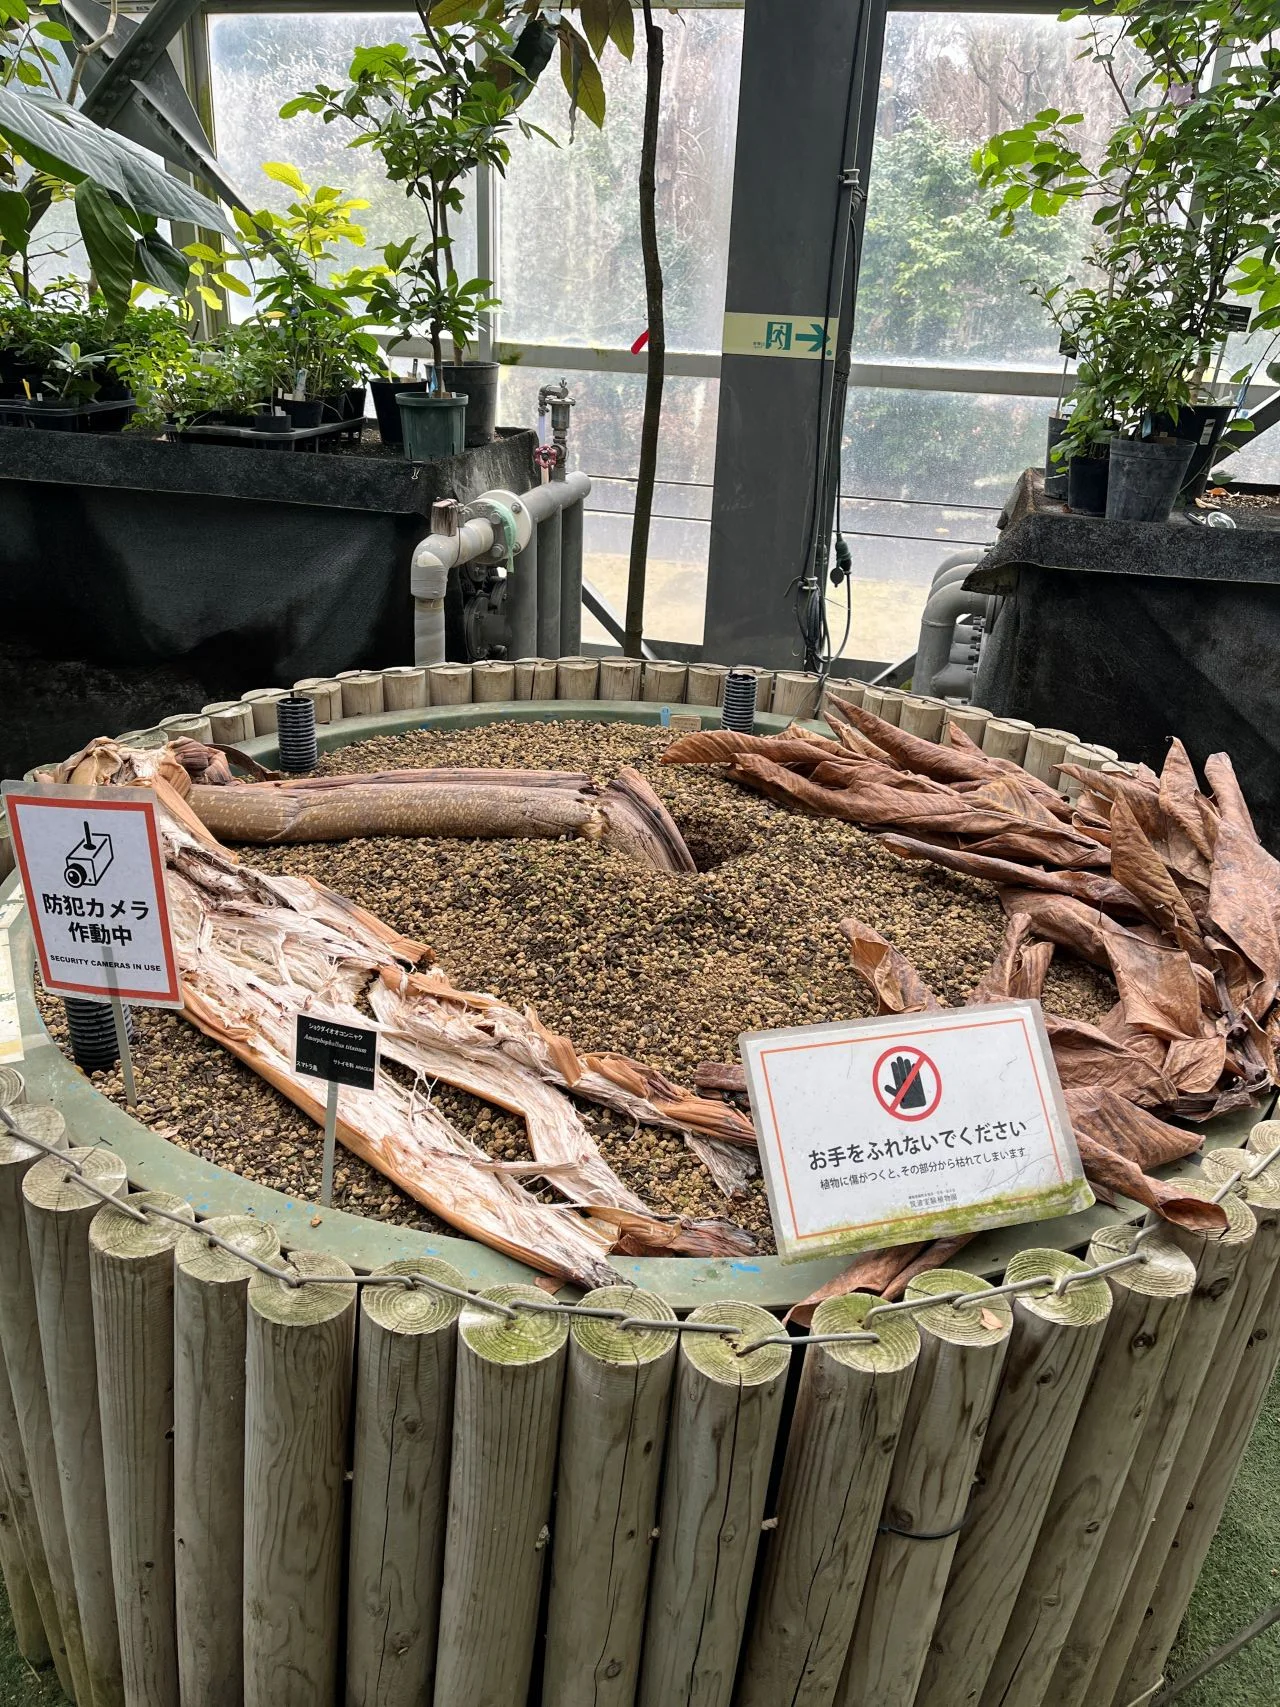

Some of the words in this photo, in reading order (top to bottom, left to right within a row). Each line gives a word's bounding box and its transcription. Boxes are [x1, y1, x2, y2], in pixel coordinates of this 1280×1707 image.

[42, 893, 150, 921] 防犯カメラ
[68, 921, 133, 947] 作動中
[50, 954, 89, 966] SECURITY
[91, 960, 131, 970] CAMERAS
[144, 964, 162, 972] USE
[808, 1120, 1028, 1171] お手をふれないでください
[820, 1146, 1026, 1191] 植物に傷がつくと、その部分から枯れてしまいます
